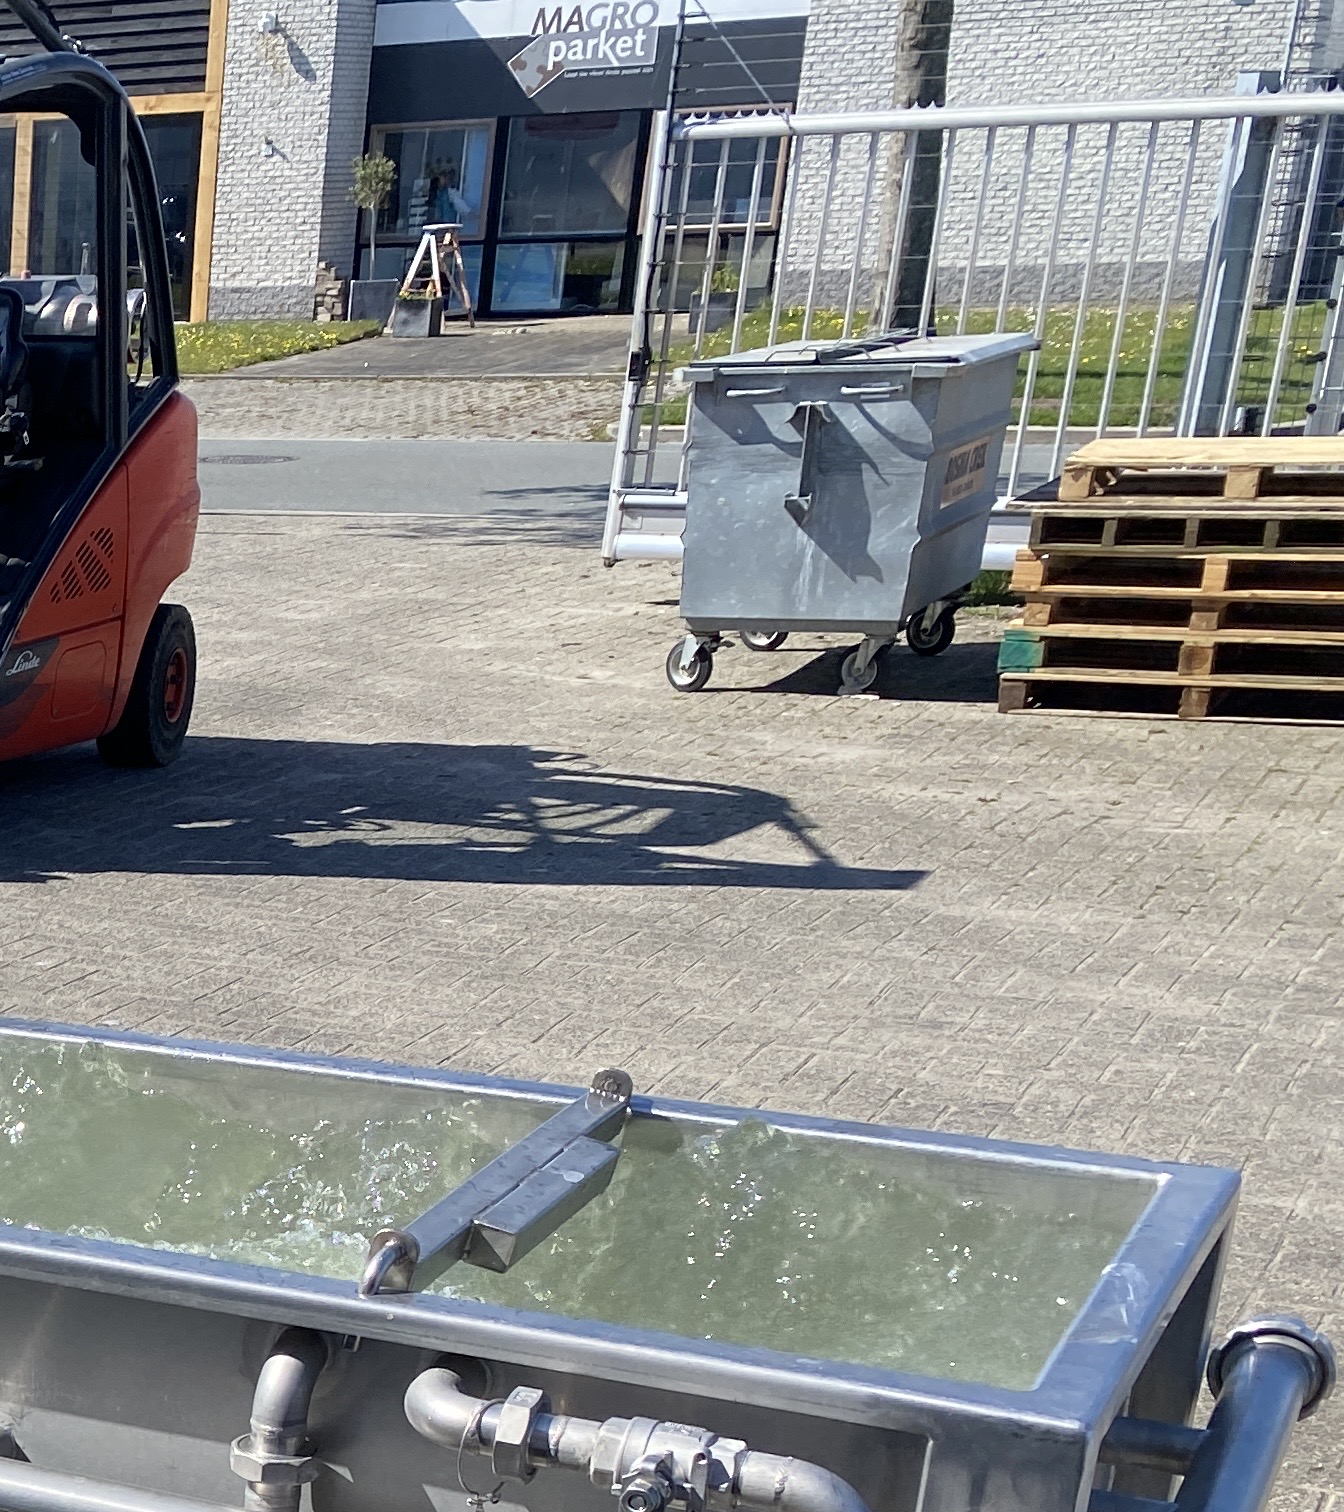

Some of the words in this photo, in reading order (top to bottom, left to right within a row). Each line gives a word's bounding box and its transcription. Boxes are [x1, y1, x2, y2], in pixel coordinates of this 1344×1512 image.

[531, 0, 660, 36] MAGRO
[546, 28, 647, 71] parket
[5, 650, 41, 677] Linde
